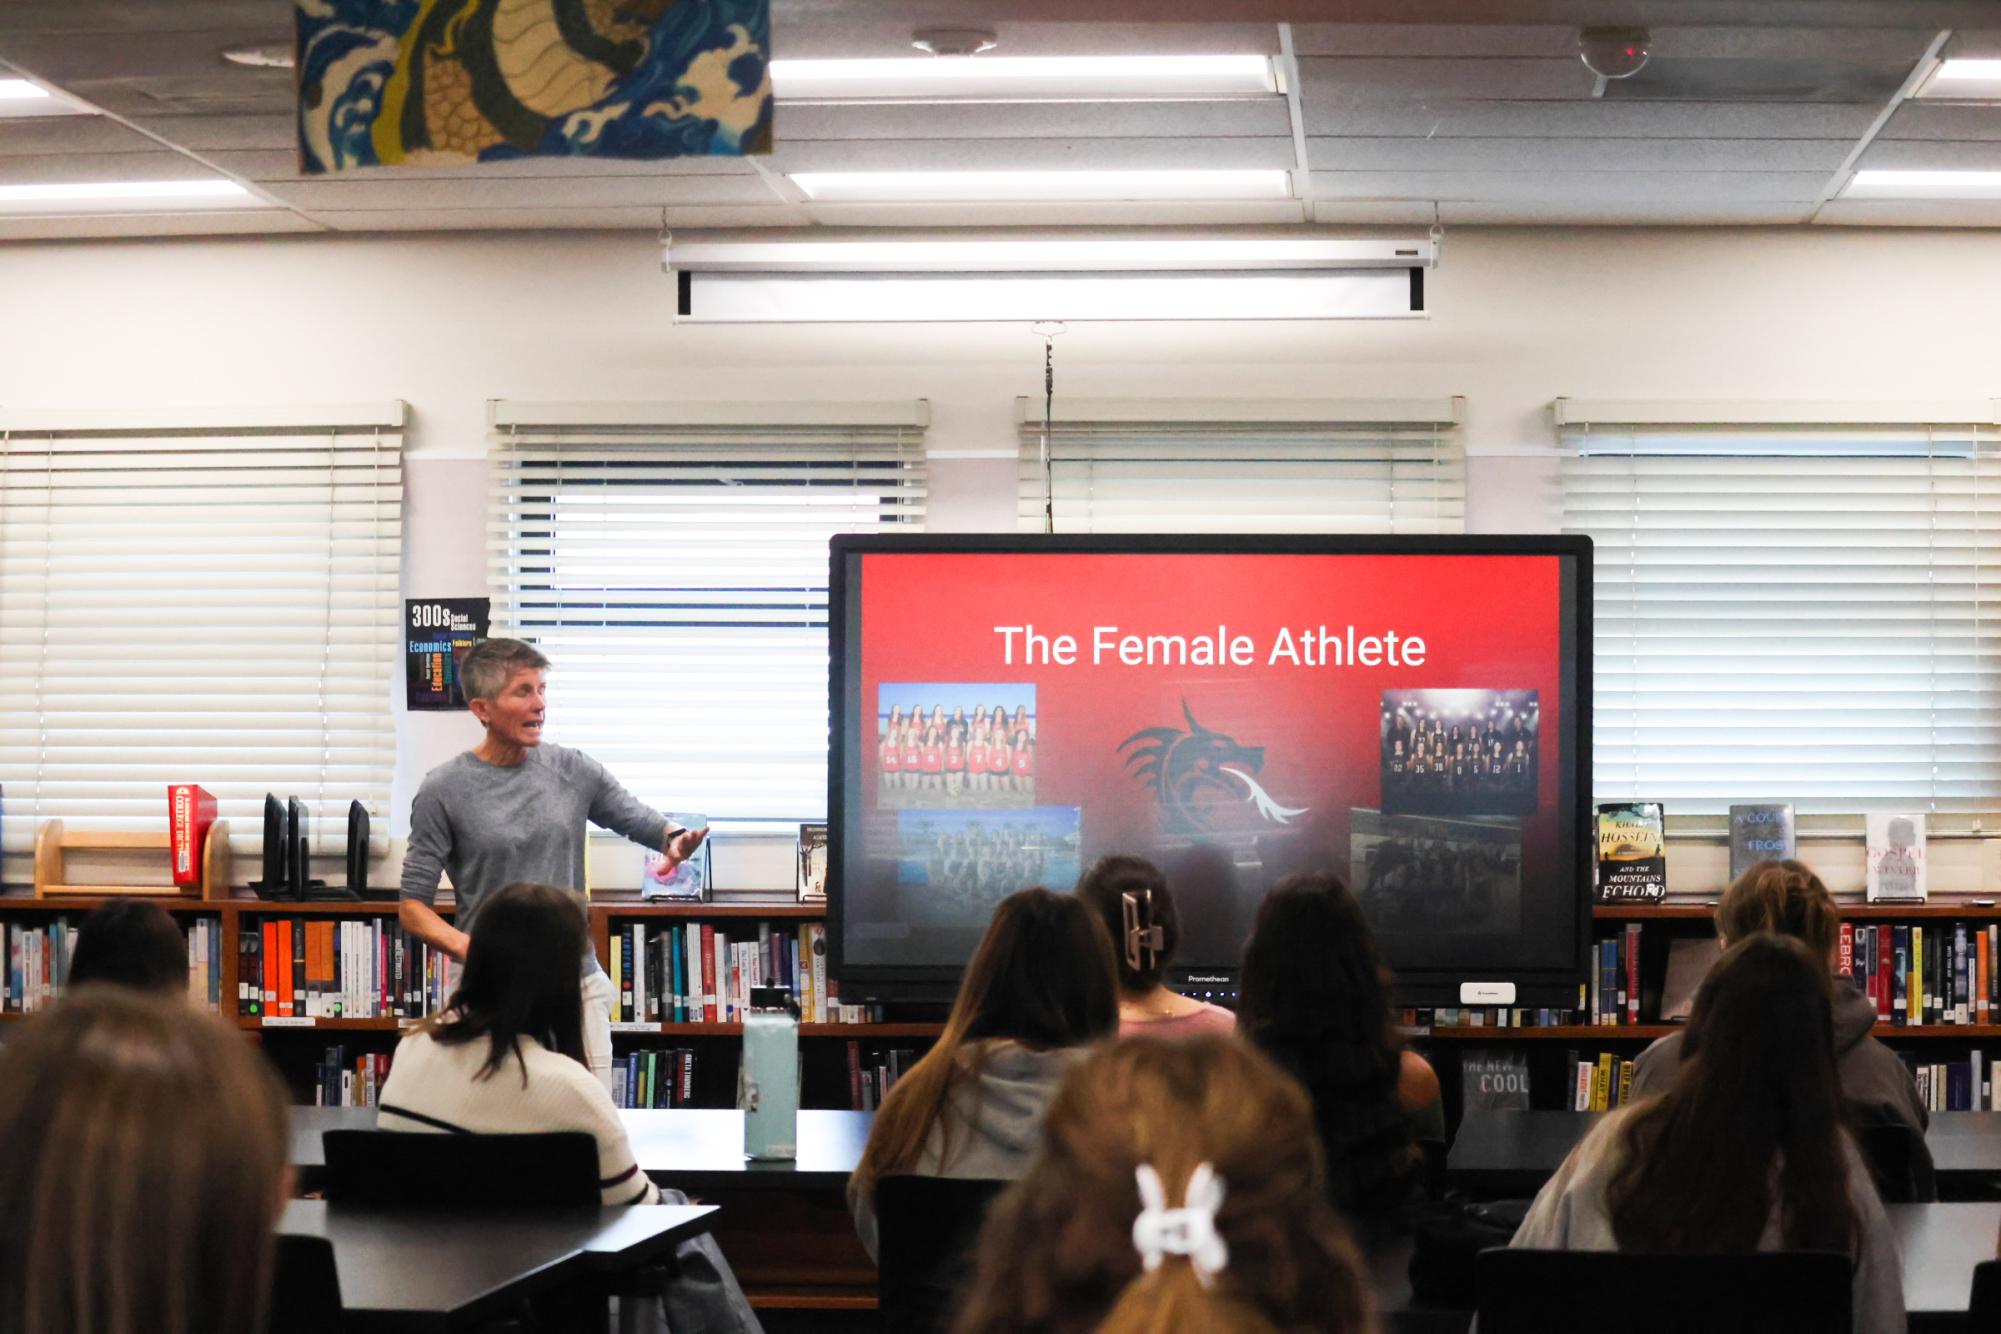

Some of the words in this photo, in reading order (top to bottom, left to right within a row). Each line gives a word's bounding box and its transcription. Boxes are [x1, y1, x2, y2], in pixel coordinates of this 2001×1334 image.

[412, 604, 450, 627] 300s
[450, 623, 477, 632] Sciences
[409, 640, 452, 653] Economics
[994, 624, 1078, 666] The
[1093, 624, 1255, 666] Female
[1267, 624, 1426, 667] Athlete
[431, 653, 443, 692] Education
[176, 795, 184, 828] COLLEGE
[1747, 840, 1788, 851] FROS
[1608, 874, 1662, 883] MOUNTAINS
[1840, 924, 1852, 976] LEBRO
[1188, 975, 1230, 983] Promethean
[684, 1053, 693, 1071] GRETA
[1463, 1061, 1483, 1073] THE
[1486, 1060, 1515, 1072] NEW
[1480, 1073, 1530, 1094] COOL
